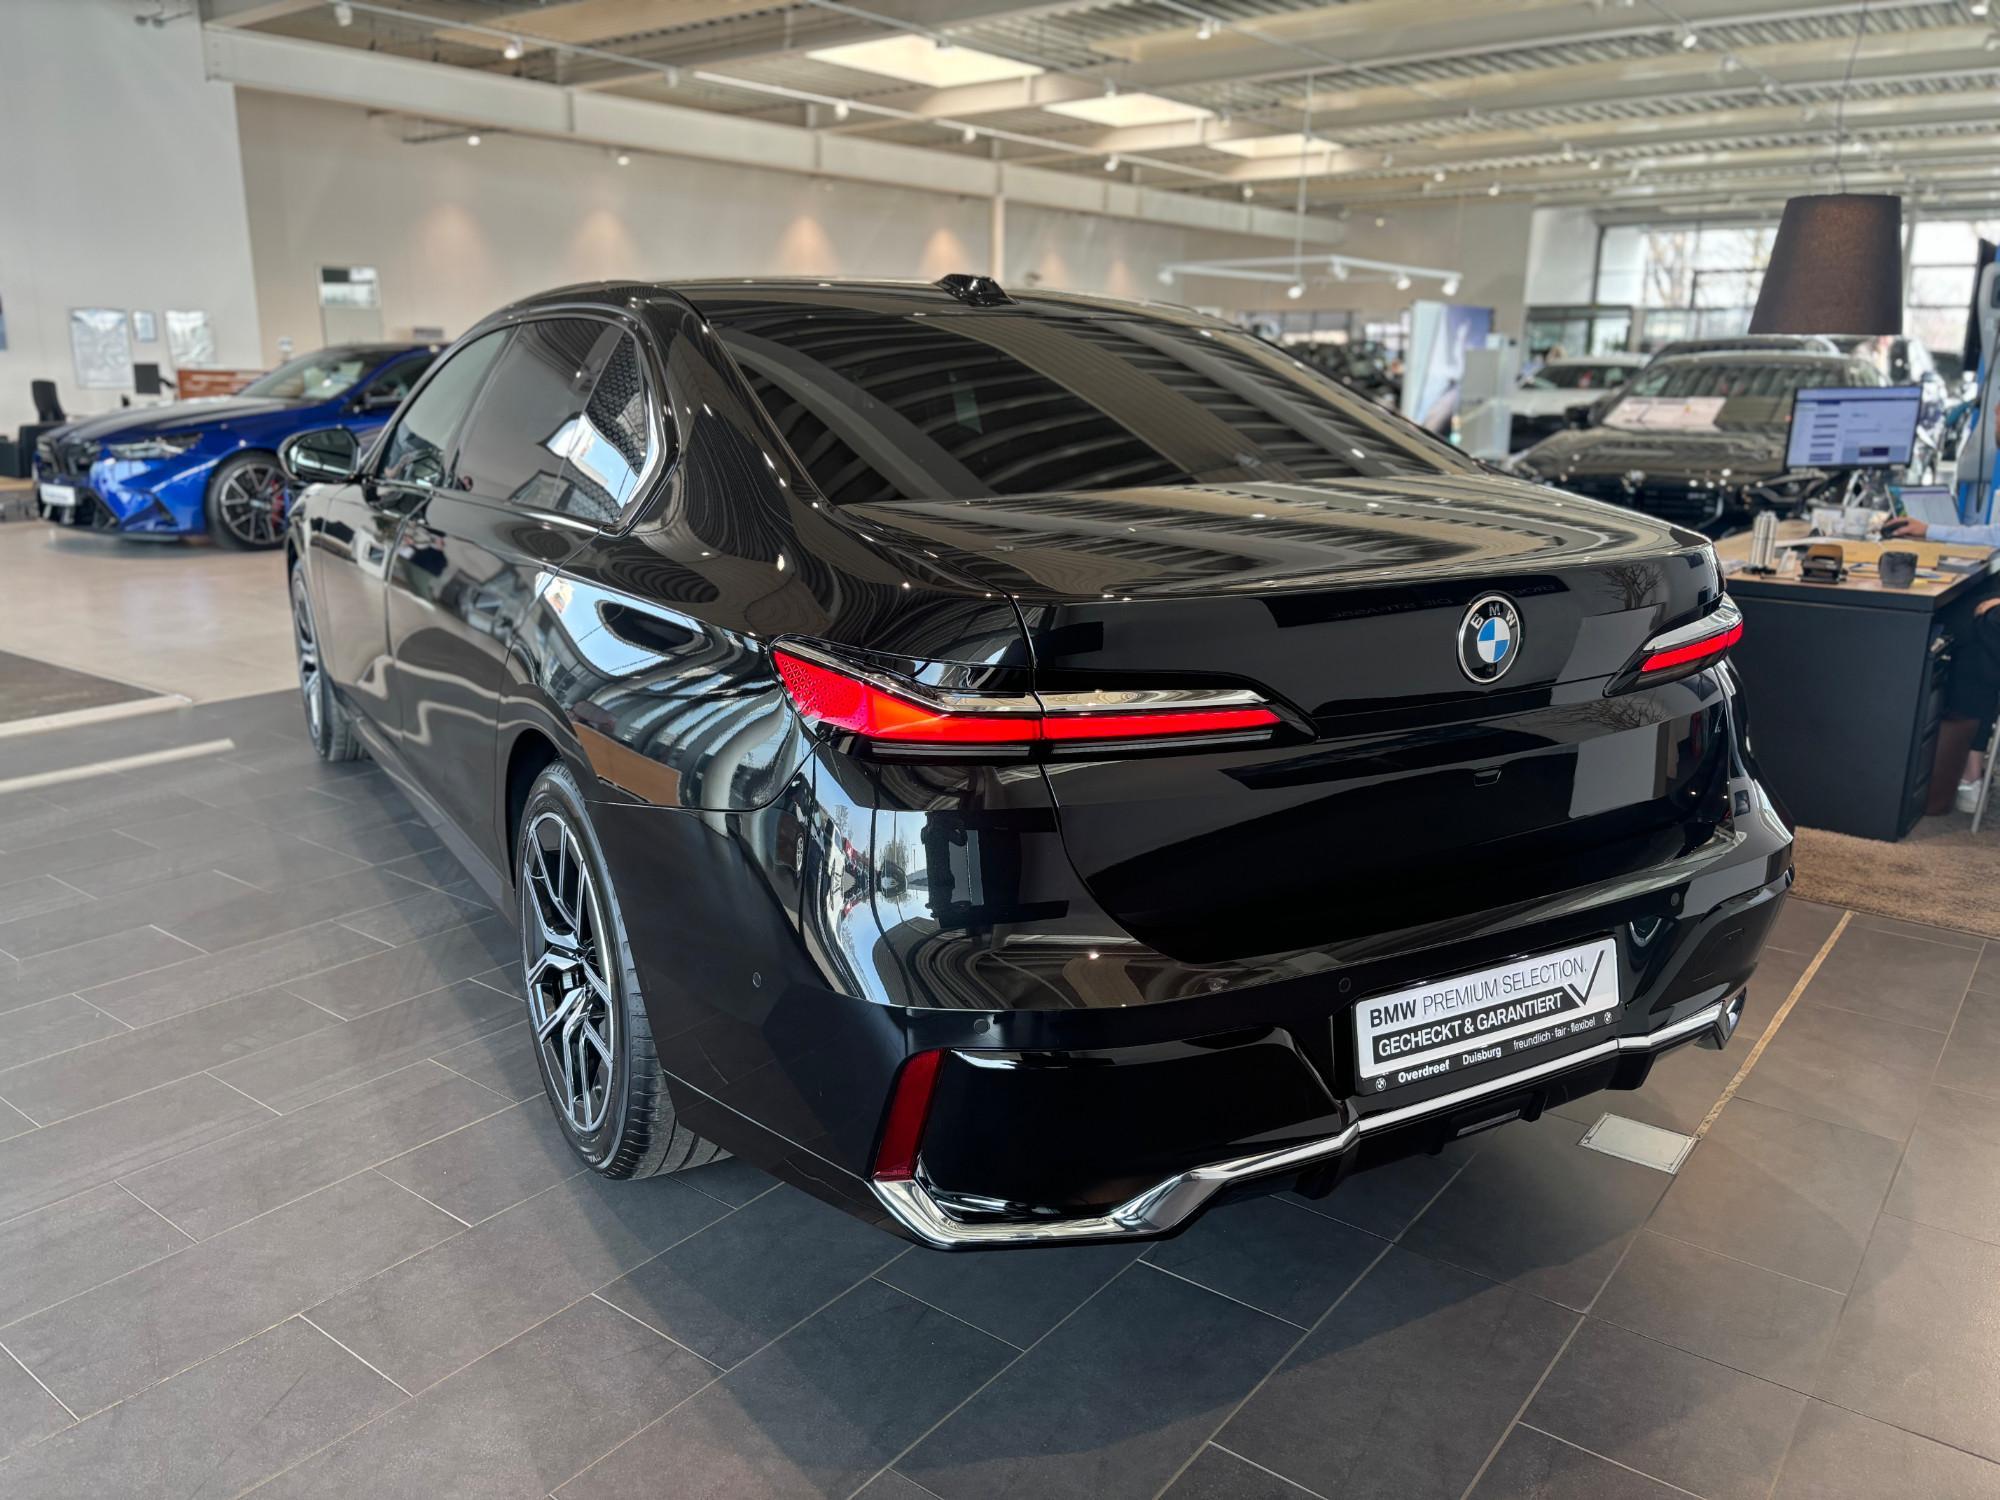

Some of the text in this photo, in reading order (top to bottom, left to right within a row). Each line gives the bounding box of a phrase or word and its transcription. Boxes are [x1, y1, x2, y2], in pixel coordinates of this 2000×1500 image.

[1470, 603, 1517, 630] BMW
[1370, 999, 1416, 1028] BMW
[1422, 978, 1499, 1016] PREMIUM
[1379, 992, 1563, 1057] GECHECKT & GARANTIERT
[1398, 1016, 1596, 1083] Overdreef Duisburg freundlich fair flexibel
